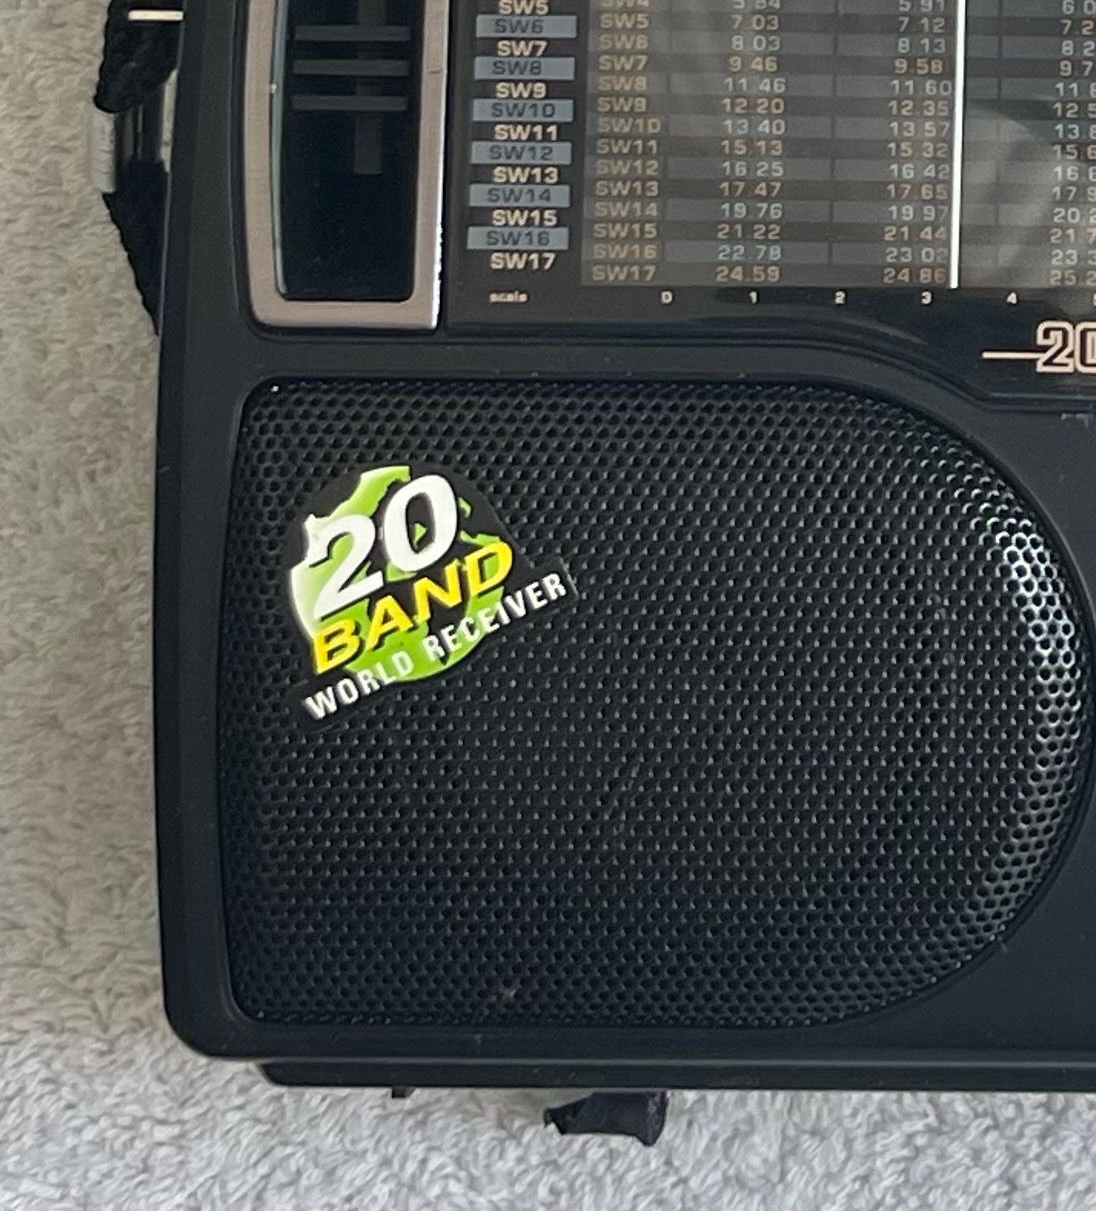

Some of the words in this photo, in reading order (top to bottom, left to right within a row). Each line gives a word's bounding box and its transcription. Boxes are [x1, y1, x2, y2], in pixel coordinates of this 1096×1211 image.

[499, 0, 549, 15] SW5
[494, 19, 544, 34] SW6
[601, 13, 650, 29] SW5
[497, 40, 547, 57] SW7
[600, 35, 648, 50] SW6
[493, 61, 542, 76] SW8
[599, 55, 648, 71] SW7
[496, 82, 547, 98] SW9
[599, 76, 647, 92] SW8
[491, 103, 555, 118] SW10
[598, 97, 647, 112] SW9
[494, 124, 558, 141] SW11
[597, 118, 662, 134] SW10
[490, 146, 553, 161] SW12
[596, 139, 658, 155] SW11
[493, 167, 558, 183] SW13
[596, 160, 659, 176] SW12
[487, 188, 552, 203] SW14
[595, 181, 659, 197] SW13
[492, 209, 557, 226] SW15
[594, 202, 658, 218] SW14
[487, 231, 550, 246] SW16
[593, 223, 658, 239] SW15
[593, 245, 657, 260] SW16
[490, 253, 556, 270] SW17
[592, 265, 656, 281] SW17
[750, 291, 759, 304] 1
[835, 292, 846, 304] 2
[922, 292, 932, 305] 3
[1007, 293, 1017, 304] 4
[309, 474, 458, 620] 20
[314, 541, 513, 676] BAND
[304, 649, 415, 720] WORLD
[422, 573, 567, 661] RECEIVER
